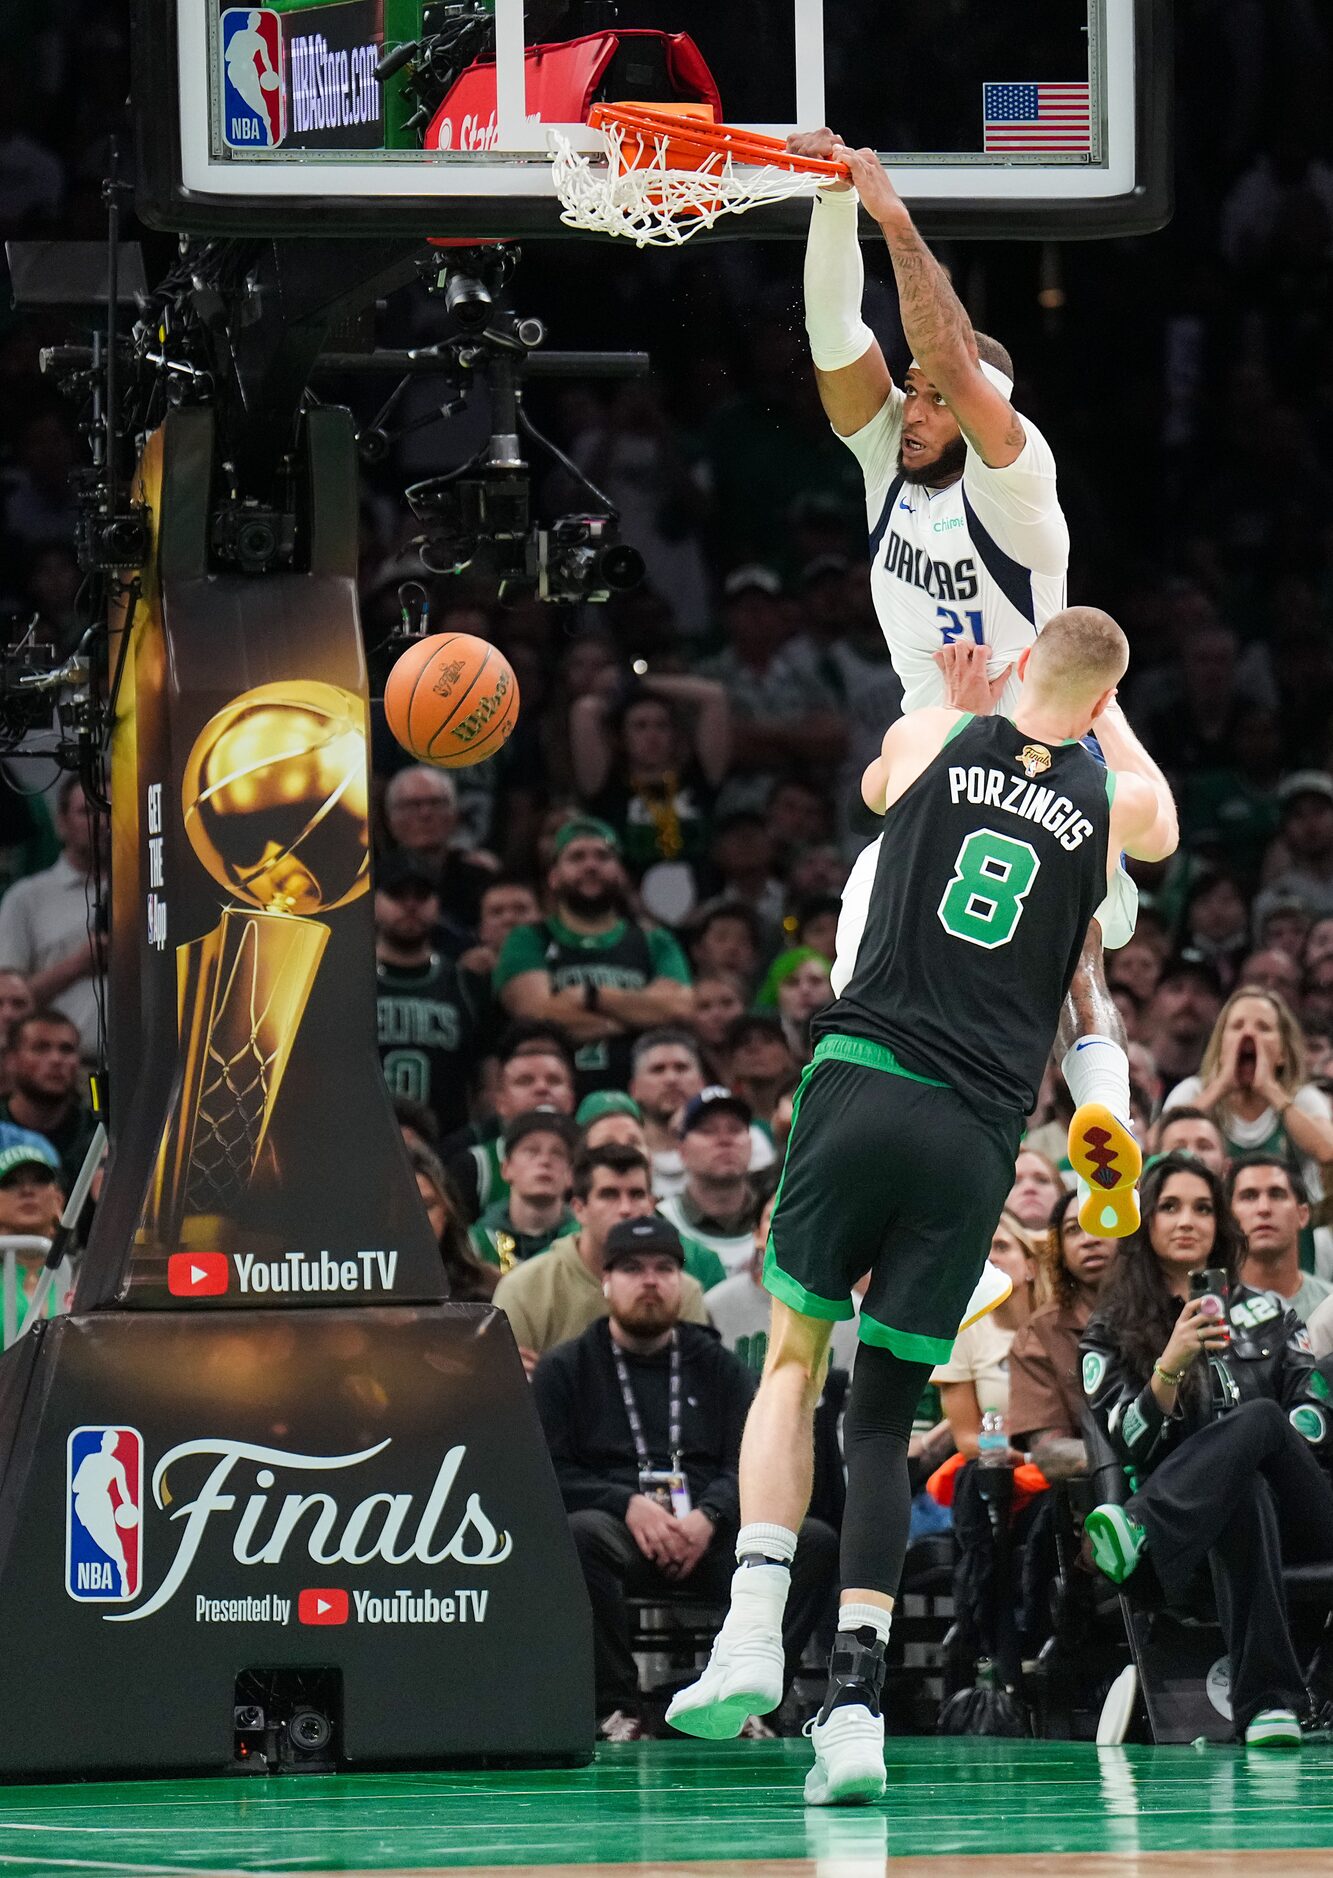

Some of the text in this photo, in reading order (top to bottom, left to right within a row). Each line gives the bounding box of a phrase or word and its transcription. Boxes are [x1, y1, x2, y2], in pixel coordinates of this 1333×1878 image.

[291, 33, 380, 133] NBAStore.com
[231, 117, 260, 140] NBA
[883, 528, 979, 601] DALLAS
[935, 605, 986, 646] 21
[1024, 746, 1050, 767] Finals
[148, 783, 162, 835] GET
[948, 766, 1094, 851] PORZINGIS
[148, 837, 164, 888] THE
[936, 827, 1041, 950] 8
[102, 1436, 513, 1622] Finals
[77, 1562, 113, 1590] NBA
[195, 1593, 270, 1623] Presented
[272, 1594, 290, 1626] by
